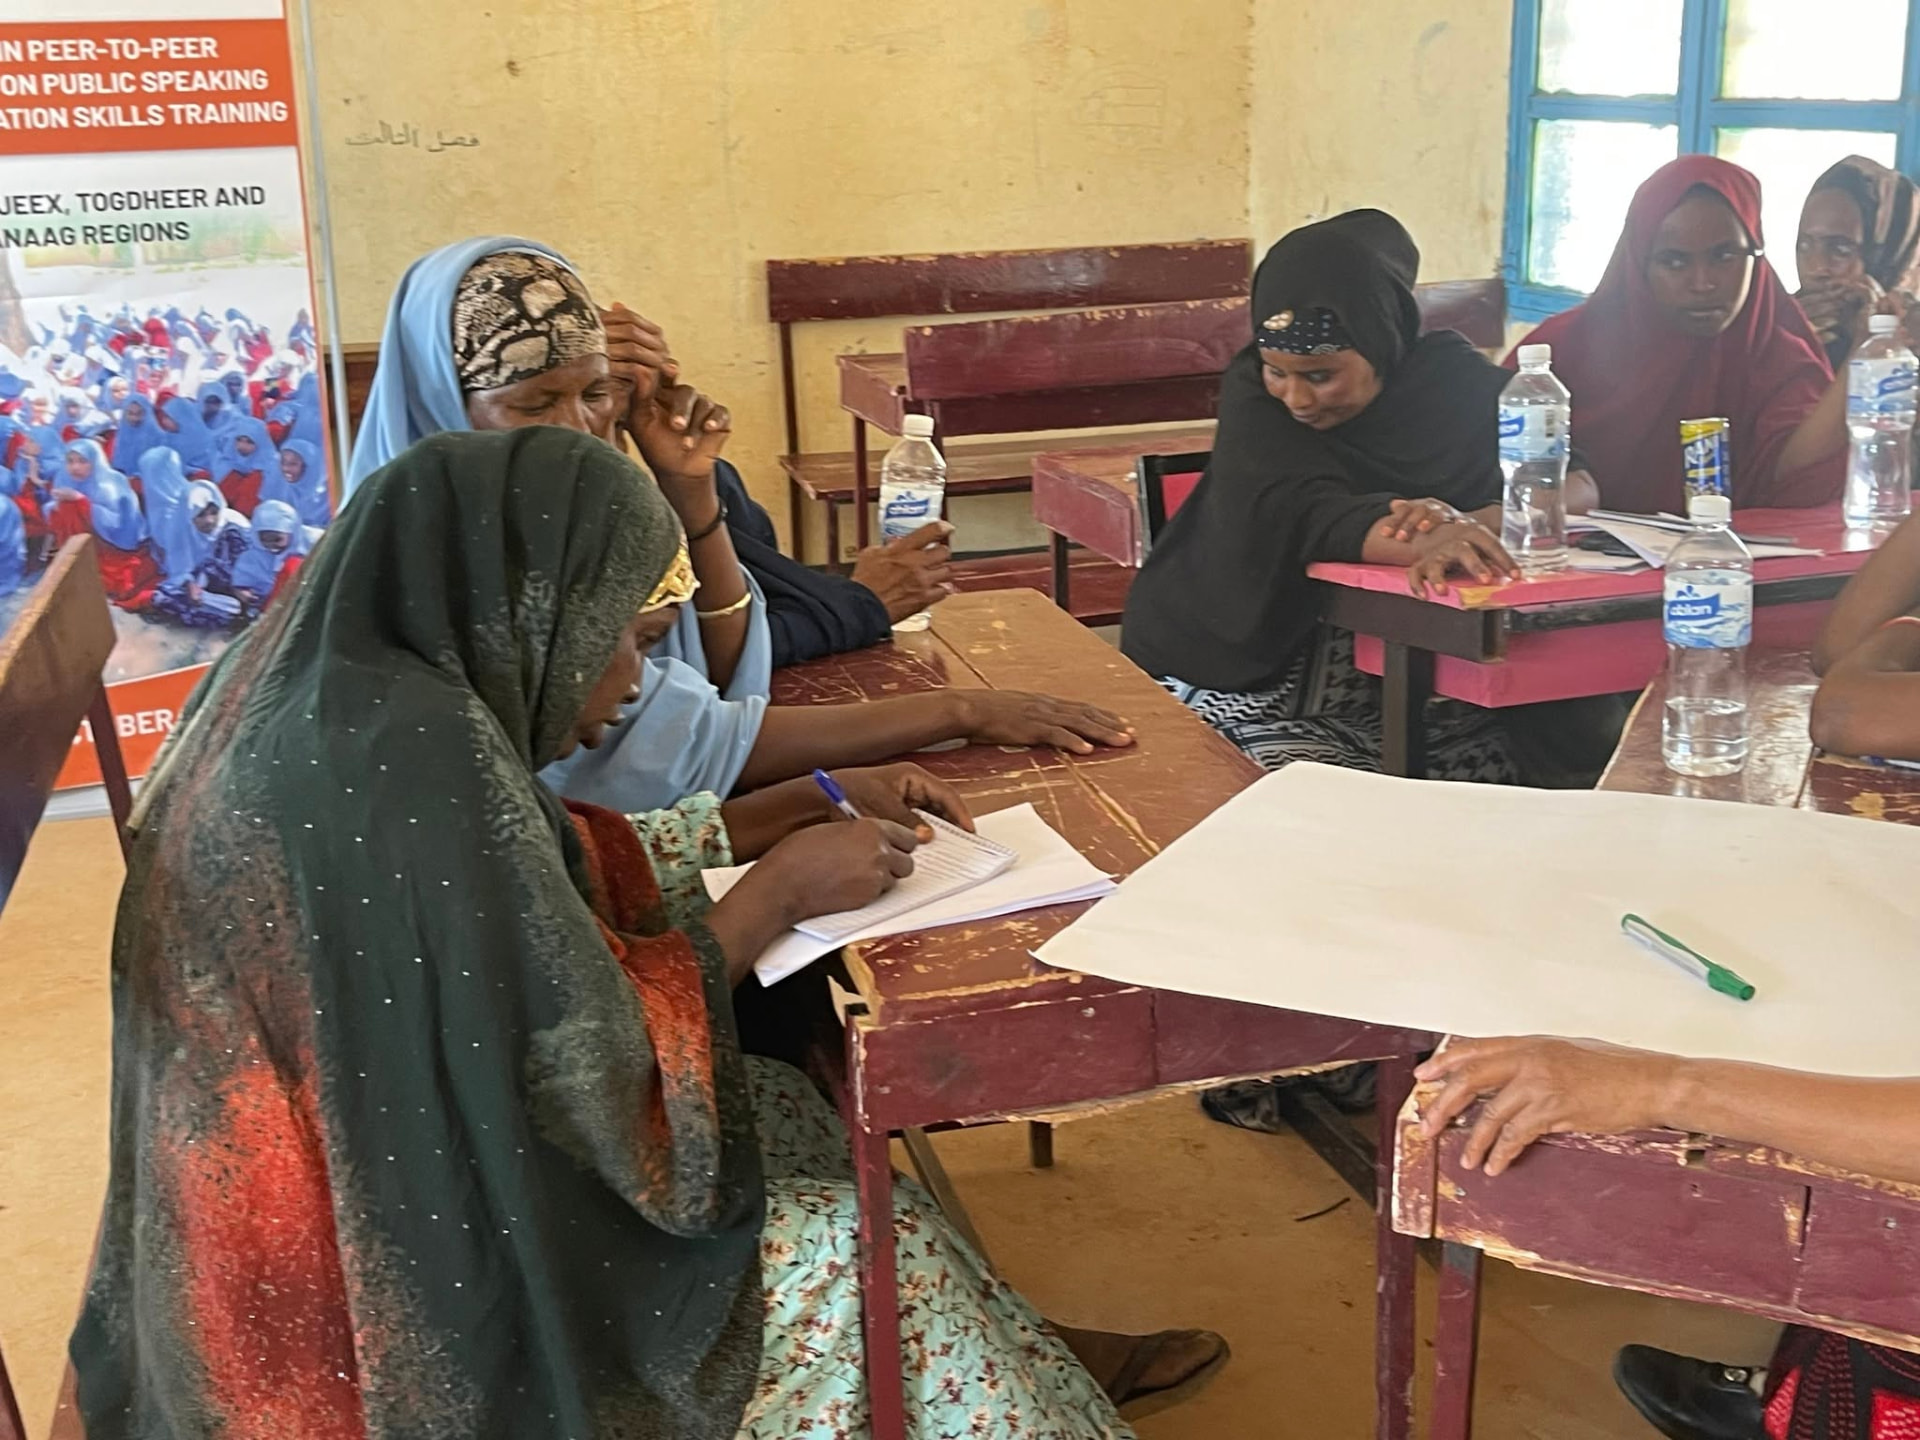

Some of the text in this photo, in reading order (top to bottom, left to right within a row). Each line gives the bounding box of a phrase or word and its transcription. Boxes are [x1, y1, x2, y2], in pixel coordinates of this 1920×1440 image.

[27, 37, 219, 62] PEER-TO-PEER
[0, 69, 268, 96] ON PUBLIC SPEAKING
[73, 104, 165, 128] SKILLS
[168, 101, 288, 125] TRAINING
[75, 188, 208, 212] TOGDHEER
[214, 186, 265, 207] AND
[0, 221, 190, 249] NAAG REGIONS
